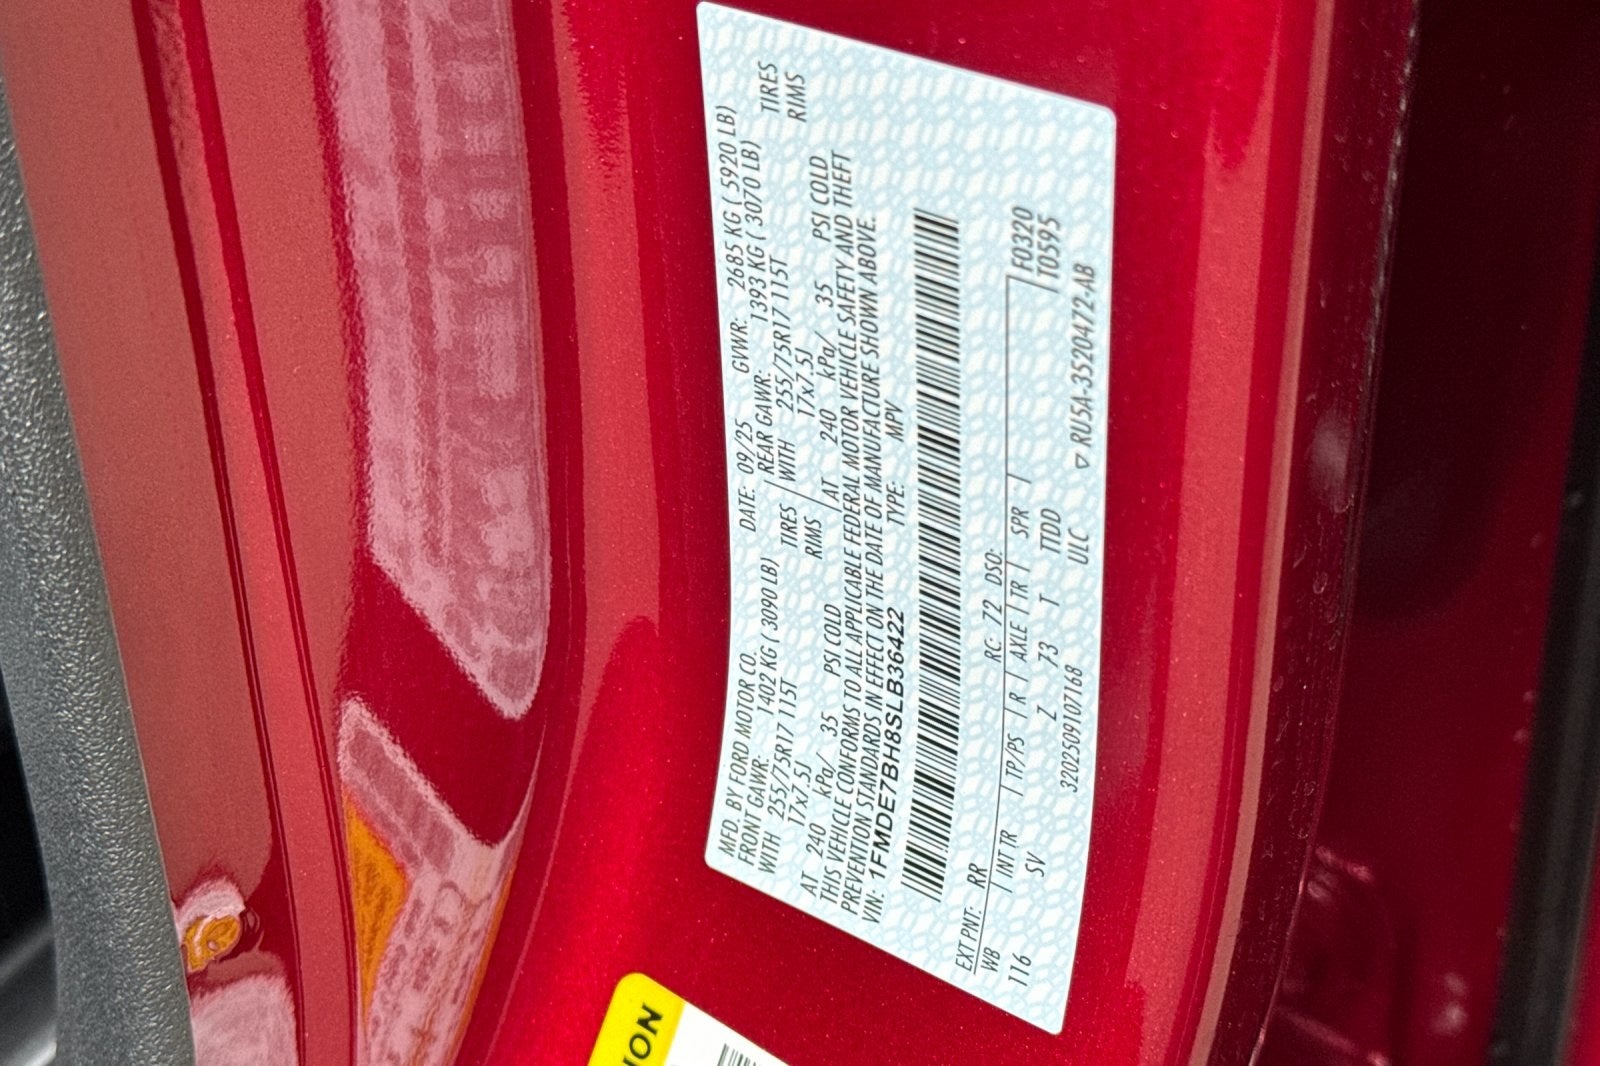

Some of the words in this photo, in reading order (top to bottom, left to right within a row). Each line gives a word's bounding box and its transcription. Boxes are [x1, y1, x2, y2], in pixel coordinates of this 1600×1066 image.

[758, 60, 780, 113] TIRES
[785, 71, 807, 122] RIMS
[716, 105, 737, 136] LB)
[718, 142, 739, 191] 5920
[740, 140, 761, 171] LB)
[809, 156, 829, 205] COLD
[831, 150, 853, 208] THEFT
[743, 177, 763, 226] 3070
[723, 211, 742, 238] KG
[811, 212, 831, 242] PSI
[834, 214, 854, 257] AND
[725, 242, 745, 291] 2685
[747, 245, 765, 272] KG
[856, 217, 877, 285] ABOVE.
[769, 254, 789, 300] 115T
[814, 281, 833, 308] 35
[835, 258, 857, 327] SAFETY
[749, 276, 768, 322] 1393
[858, 286, 879, 356] SHOWN
[730, 318, 749, 373] GVWR:
[772, 307, 794, 413] 255/75R17
[814, 331, 837, 381] kPa/
[838, 329, 857, 400] VEHICLE
[754, 370, 773, 426] GAWR:
[795, 347, 815, 417] 17x7.5J
[819, 409, 838, 446] 240
[841, 405, 860, 471] MOTOR
[860, 361, 882, 493] MANUFACTURE
[884, 399, 904, 443] MPV
[735, 419, 754, 474] 09/25
[757, 431, 774, 475] REAR
[778, 439, 796, 481] WITH
[738, 487, 756, 532] DATE:
[821, 477, 839, 502] AT
[842, 475, 861, 546] FEDERAL
[864, 494, 882, 519] OF
[886, 481, 905, 527] TYPE:
[779, 503, 798, 548] TIRES
[865, 521, 883, 566] DATE
[1011, 506, 1029, 539] SPR
[985, 548, 1002, 586] DSO:
[1068, 528, 1089, 565] ULC
[760, 557, 779, 585] LB)
[865, 567, 883, 600] THE
[1010, 580, 1028, 600] TR
[761, 587, 778, 631] 3090
[844, 547, 862, 646] APPLICABLE
[865, 602, 884, 630] ON
[982, 599, 1002, 627] 72
[1039, 593, 1060, 606] T
[824, 604, 841, 646] COLD
[1009, 621, 1027, 663] AXLE
[739, 652, 757, 675] CO.
[760, 645, 777, 671] KG
[788, 760, 811, 827] 17x7.5J
[804, 516, 823, 560] RIMS
[824, 649, 841, 677] PSI
[844, 648, 862, 677] ALL
[866, 631, 884, 689] EFFECT
[984, 638, 1002, 663] RC:
[1038, 641, 1058, 668] 73
[734, 679, 755, 739] MOTOR
[757, 673, 776, 715] 1402
[776, 677, 797, 719] 115T
[844, 679, 862, 701] TO
[864, 689, 883, 711] IN
[1009, 692, 1026, 705] R
[821, 712, 838, 737] 35
[1037, 704, 1057, 722] Z
[1060, 664, 1082, 793] 3202509107168
[729, 741, 749, 785] FORD
[836, 704, 861, 794] CONFORMS
[856, 713, 881, 811] STANDARDS
[868, 606, 904, 880] 1FMDE7BH8SLB36422
[1005, 733, 1025, 780] TP/PS
[747, 755, 769, 808] GAWR:
[767, 723, 794, 820] 255/75R17
[812, 752, 836, 798] kPa/
[725, 787, 742, 812] BY
[718, 819, 740, 857] MFD.
[738, 809, 761, 866] FRONT
[806, 822, 826, 858] 240
[826, 797, 852, 863] VEHICLE
[999, 830, 1017, 848] TR
[758, 832, 781, 875] WITH
[840, 812, 872, 915] PREVENTION
[996, 849, 1015, 878] INT
[1025, 851, 1045, 877] SV
[801, 871, 818, 897] AT
[820, 866, 842, 904] THIS
[967, 862, 987, 889] RR
[861, 889, 885, 924] VIN:
[961, 906, 982, 942] PNT:
[955, 940, 975, 972] EXT
[981, 947, 1000, 972] WB
[1008, 953, 1032, 987] 116
